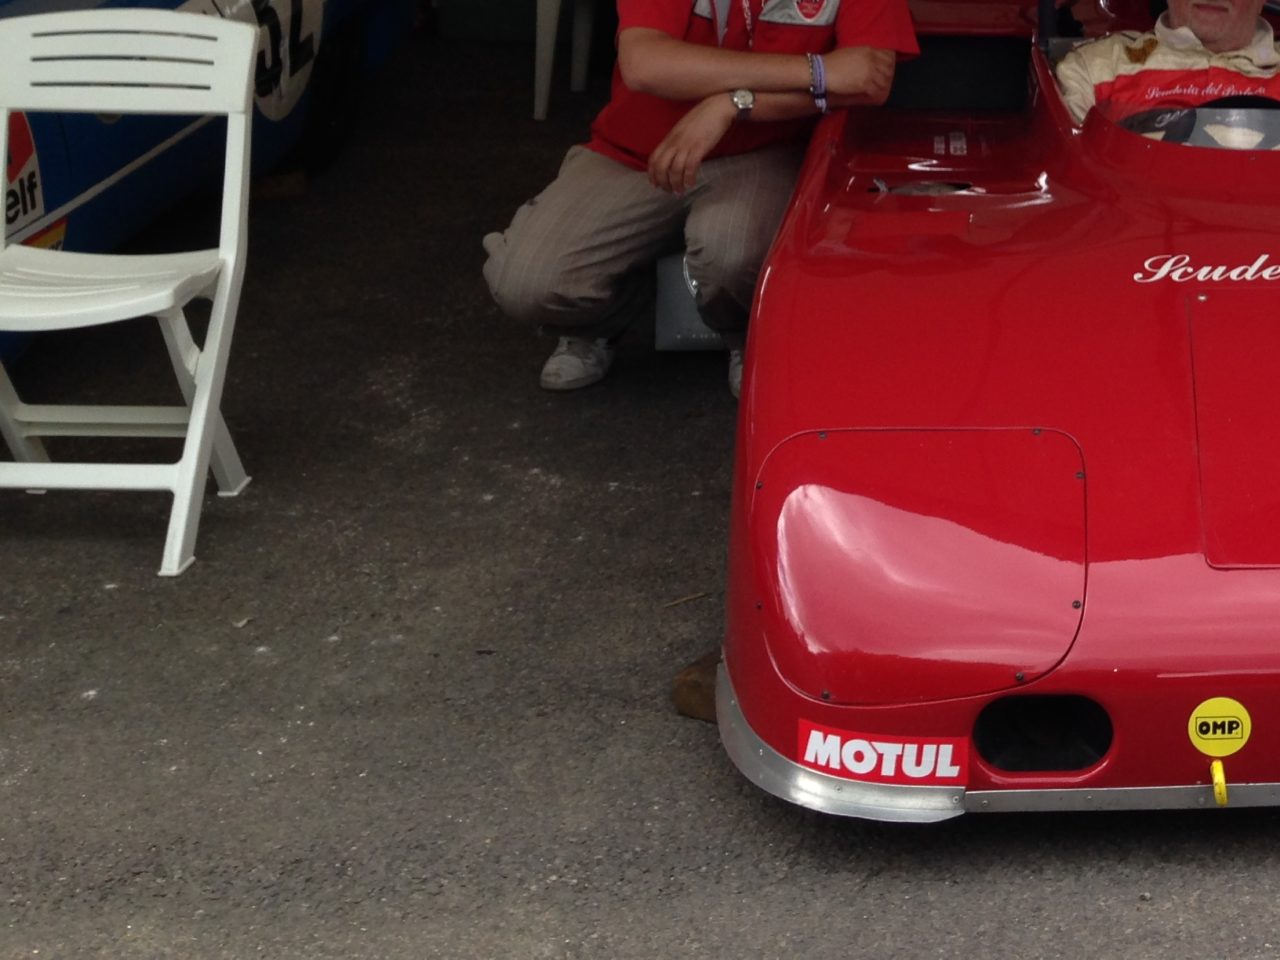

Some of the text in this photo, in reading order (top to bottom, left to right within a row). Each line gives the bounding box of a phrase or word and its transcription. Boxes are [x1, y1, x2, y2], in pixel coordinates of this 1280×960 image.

[6, 170, 38, 225] elf
[1198, 717, 1242, 738] OMP
[803, 729, 962, 779] MOTUL
